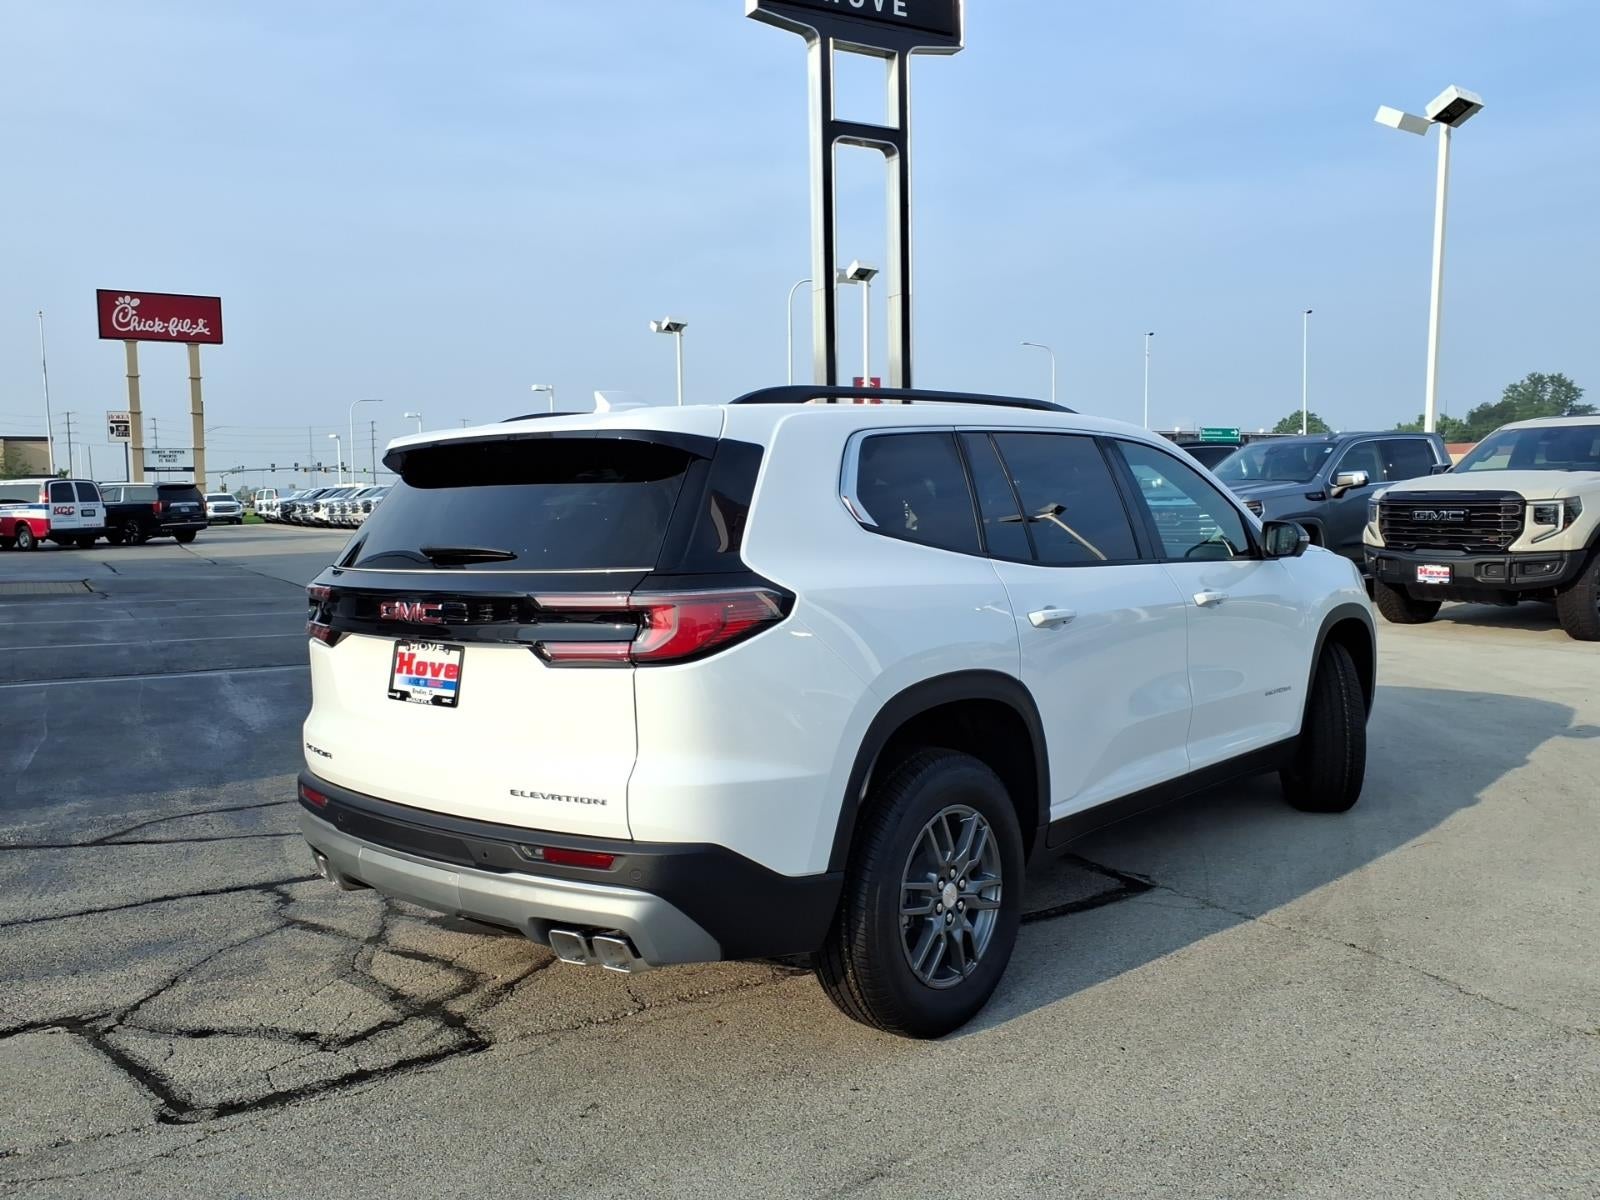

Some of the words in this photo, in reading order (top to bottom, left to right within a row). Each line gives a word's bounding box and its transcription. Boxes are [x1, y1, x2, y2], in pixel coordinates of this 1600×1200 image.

[111, 301, 212, 337] Chick-fil-A
[1412, 510, 1465, 521] GMC
[380, 601, 443, 624] GMC
[410, 642, 445, 652] HOVE
[396, 652, 460, 680] Hove
[509, 789, 608, 806] ELEVATION
